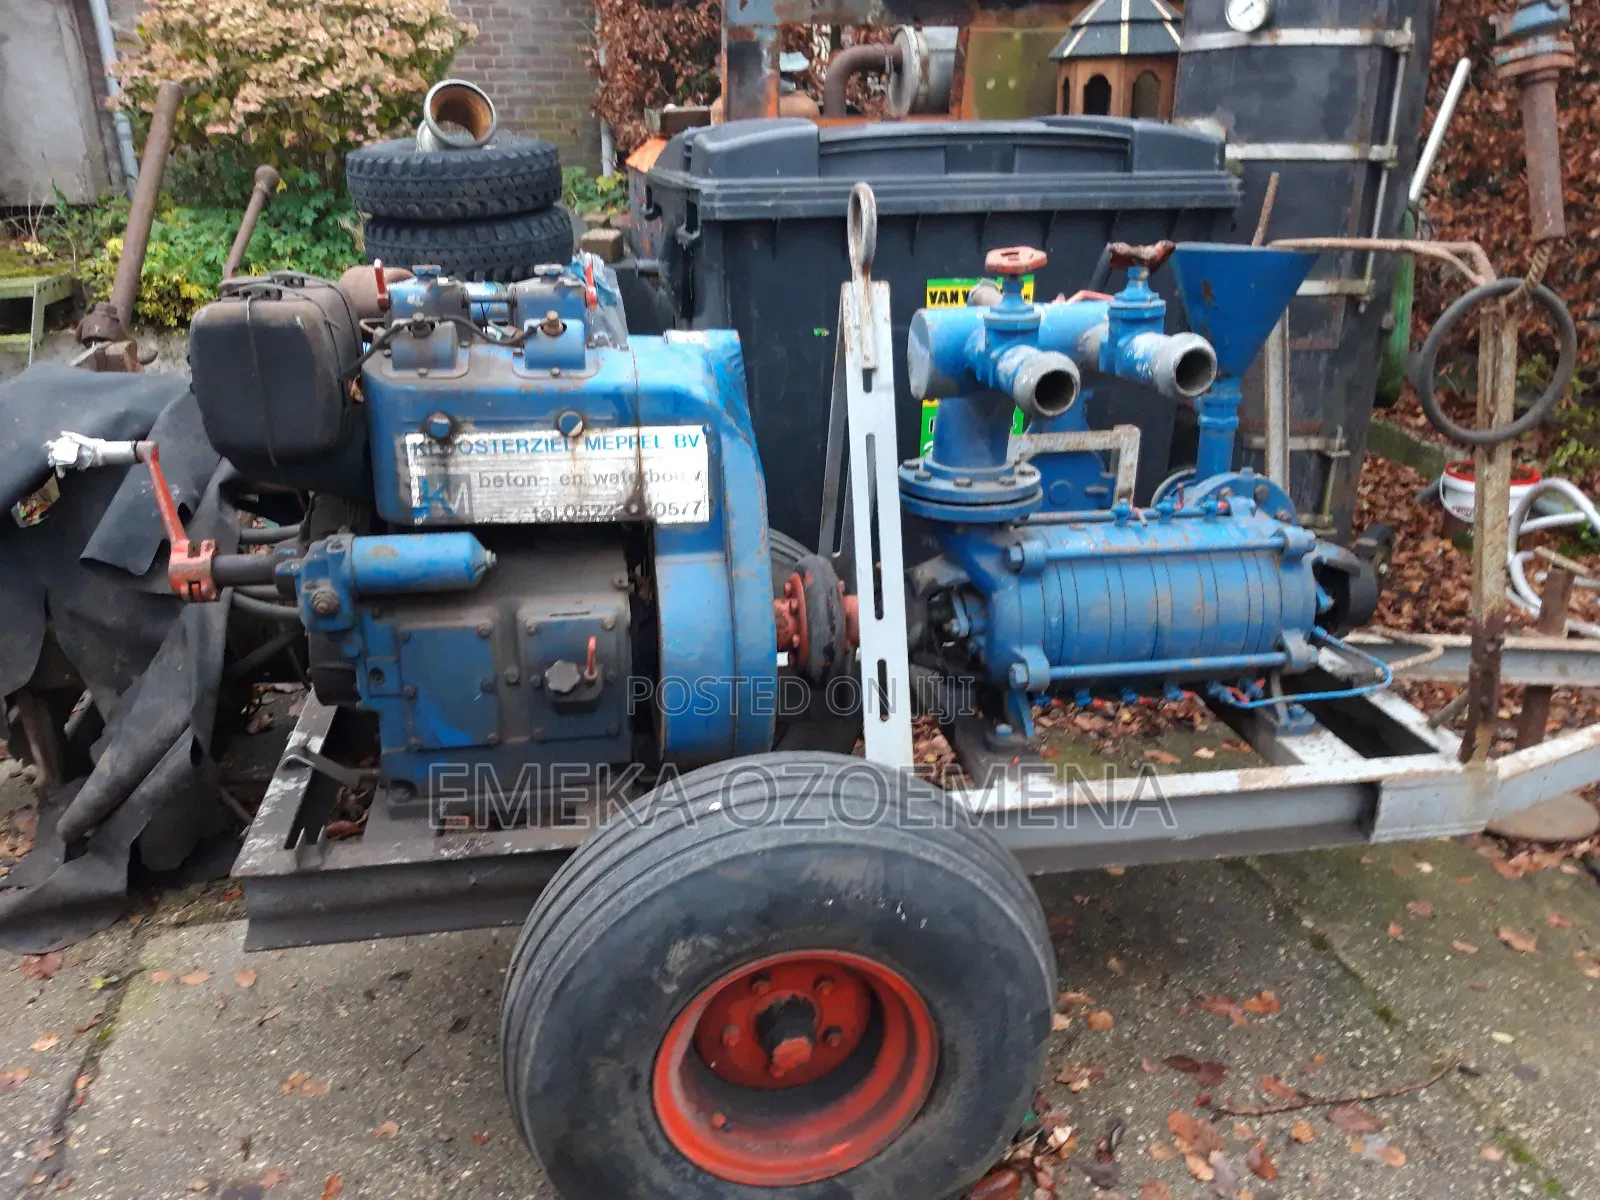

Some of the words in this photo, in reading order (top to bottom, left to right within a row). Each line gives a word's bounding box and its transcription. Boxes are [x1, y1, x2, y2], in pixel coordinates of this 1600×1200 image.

[928, 289, 959, 305] VAN
[411, 435, 573, 456] KLOSTERZIEL
[674, 434, 700, 449] BV
